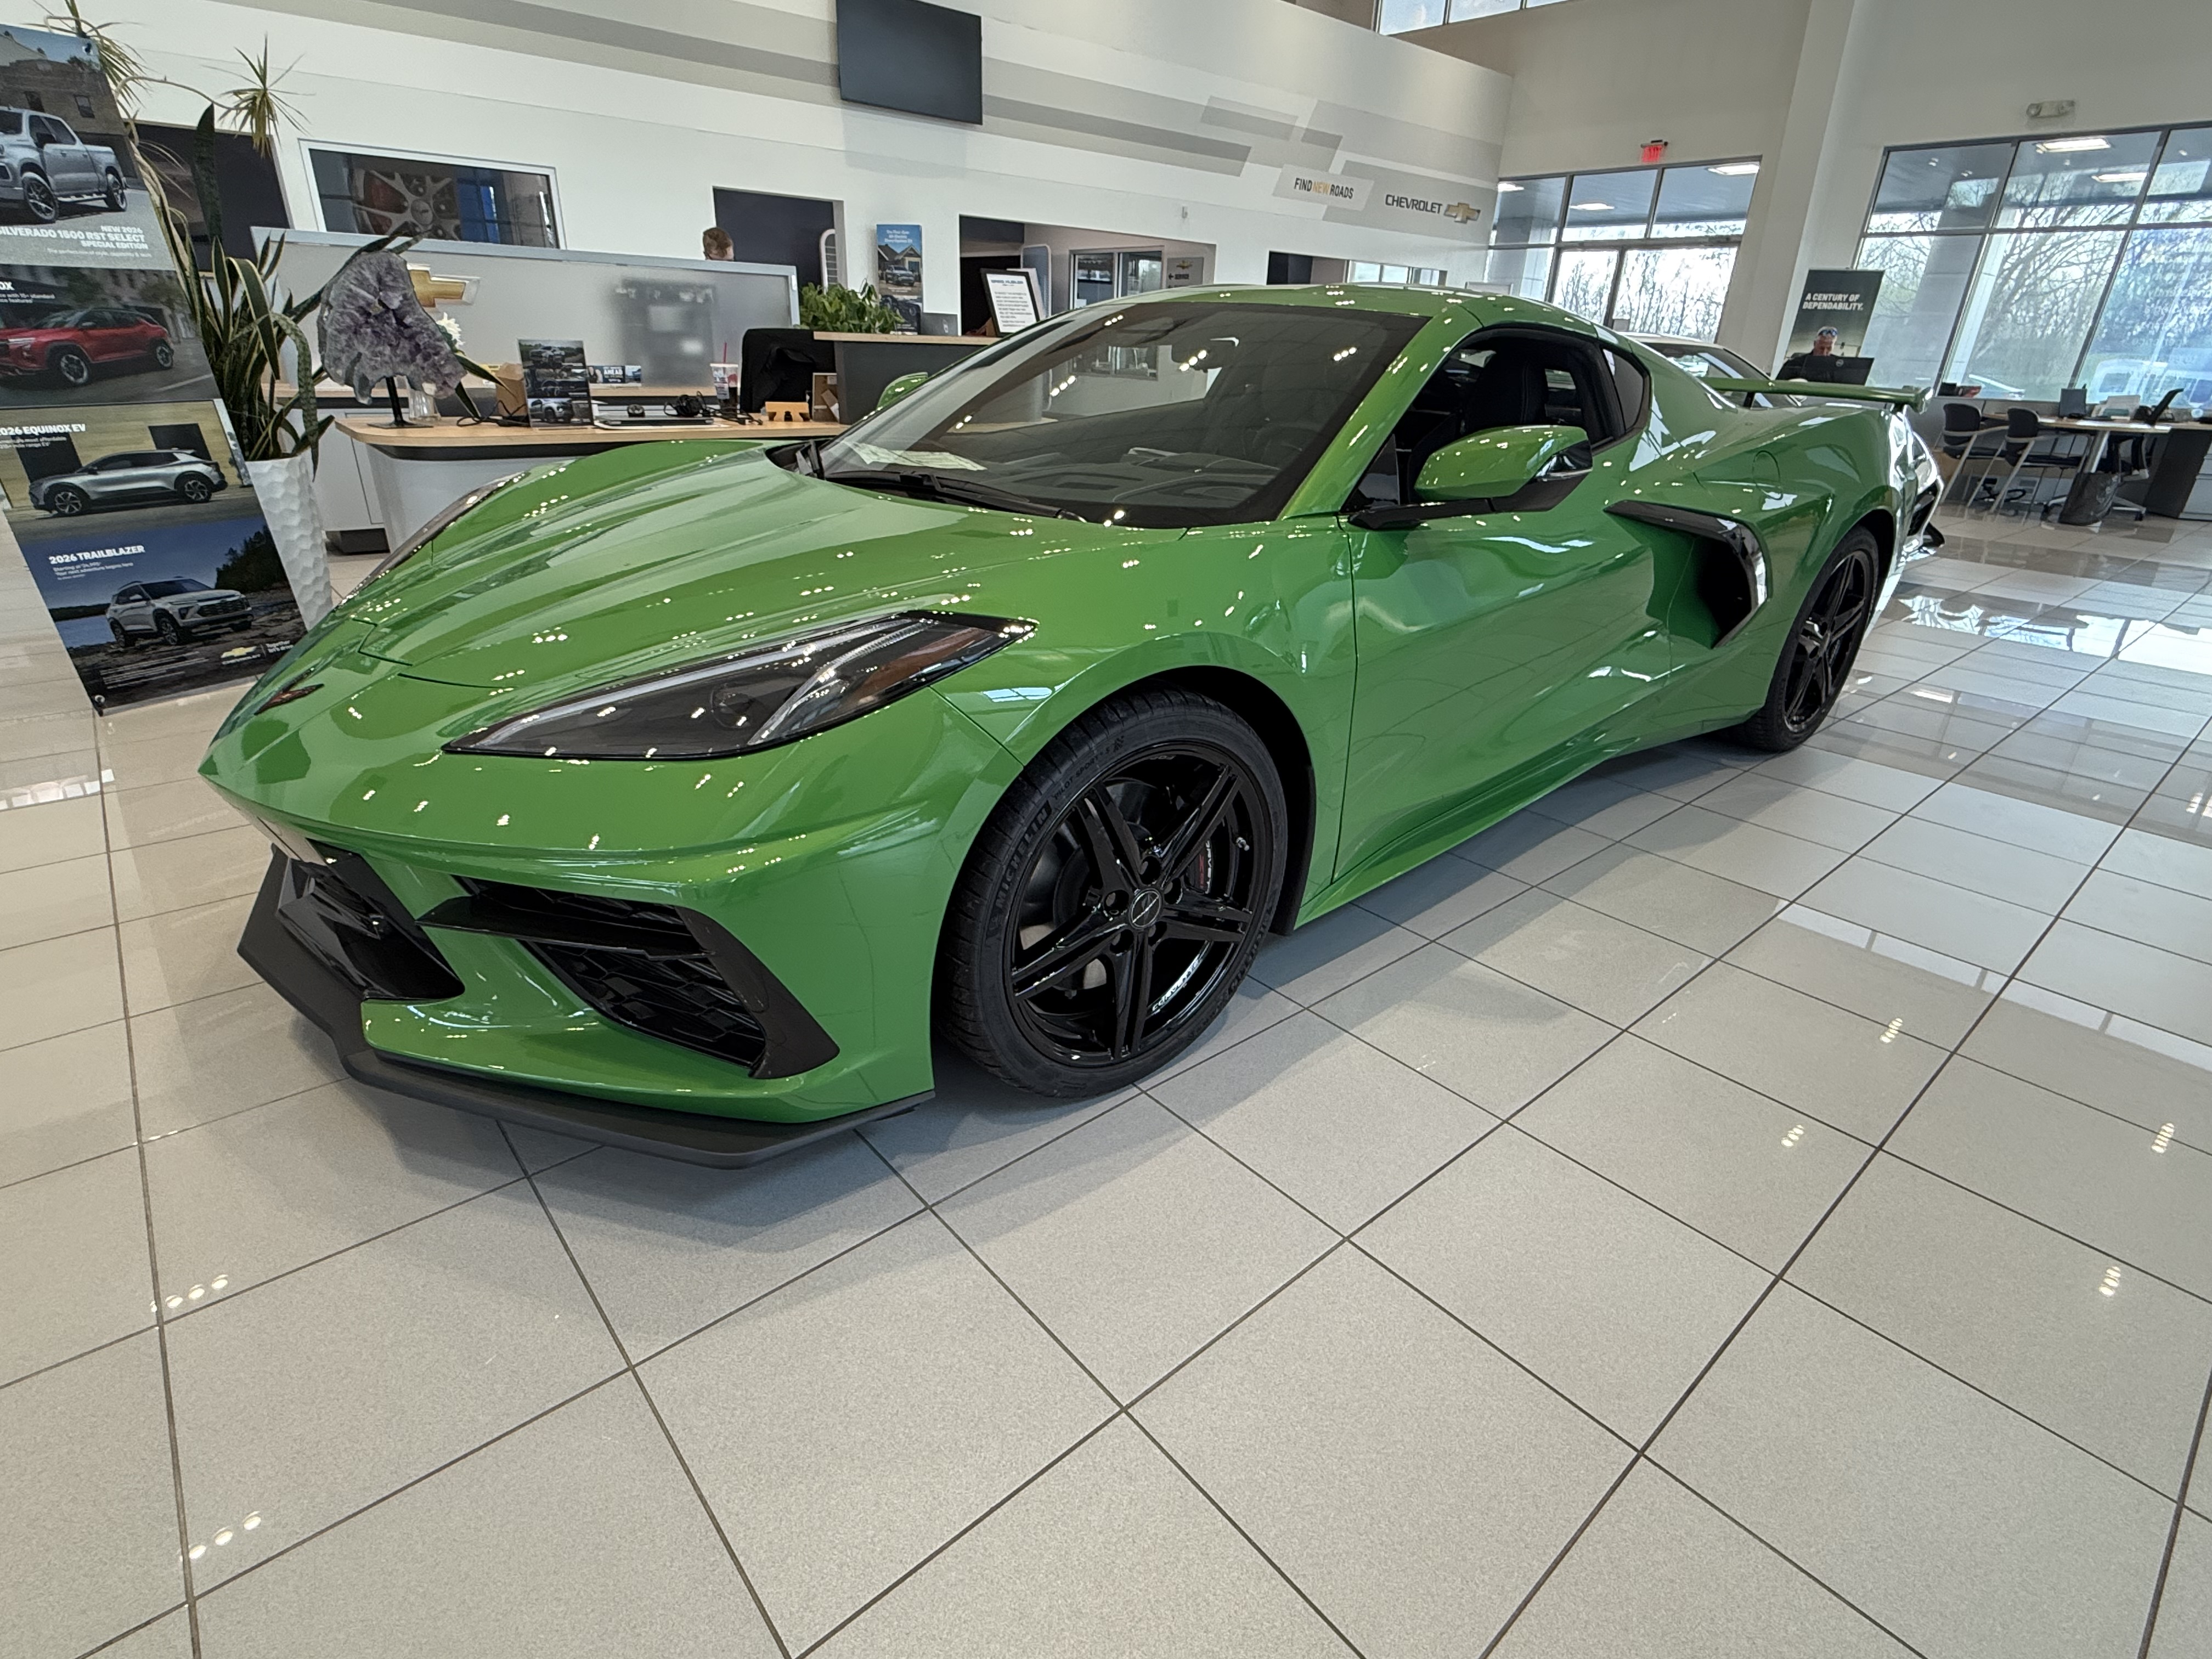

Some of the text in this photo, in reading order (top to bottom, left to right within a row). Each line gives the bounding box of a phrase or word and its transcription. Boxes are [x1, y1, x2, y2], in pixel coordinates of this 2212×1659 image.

[1294, 177, 1354, 199] FIND NEW ROADS
[1385, 194, 1443, 214] CHEVROLET
[57, 229, 85, 239] 1500
[86, 232, 106, 240] RST
[107, 233, 145, 242] SELECT
[81, 240, 116, 248] SPECIAL
[1812, 293, 1848, 301] CENTURY
[1802, 302, 1864, 311] DEPENDABILITY.
[22, 424, 72, 436] EQUINOX
[71, 424, 86, 432] EV
[49, 545, 145, 565] 2026 TRAILBLAZER
[1054, 777, 1074, 800] PILOT
[1076, 756, 1099, 778] SPORT
[995, 802, 1051, 910] MICHELIN
